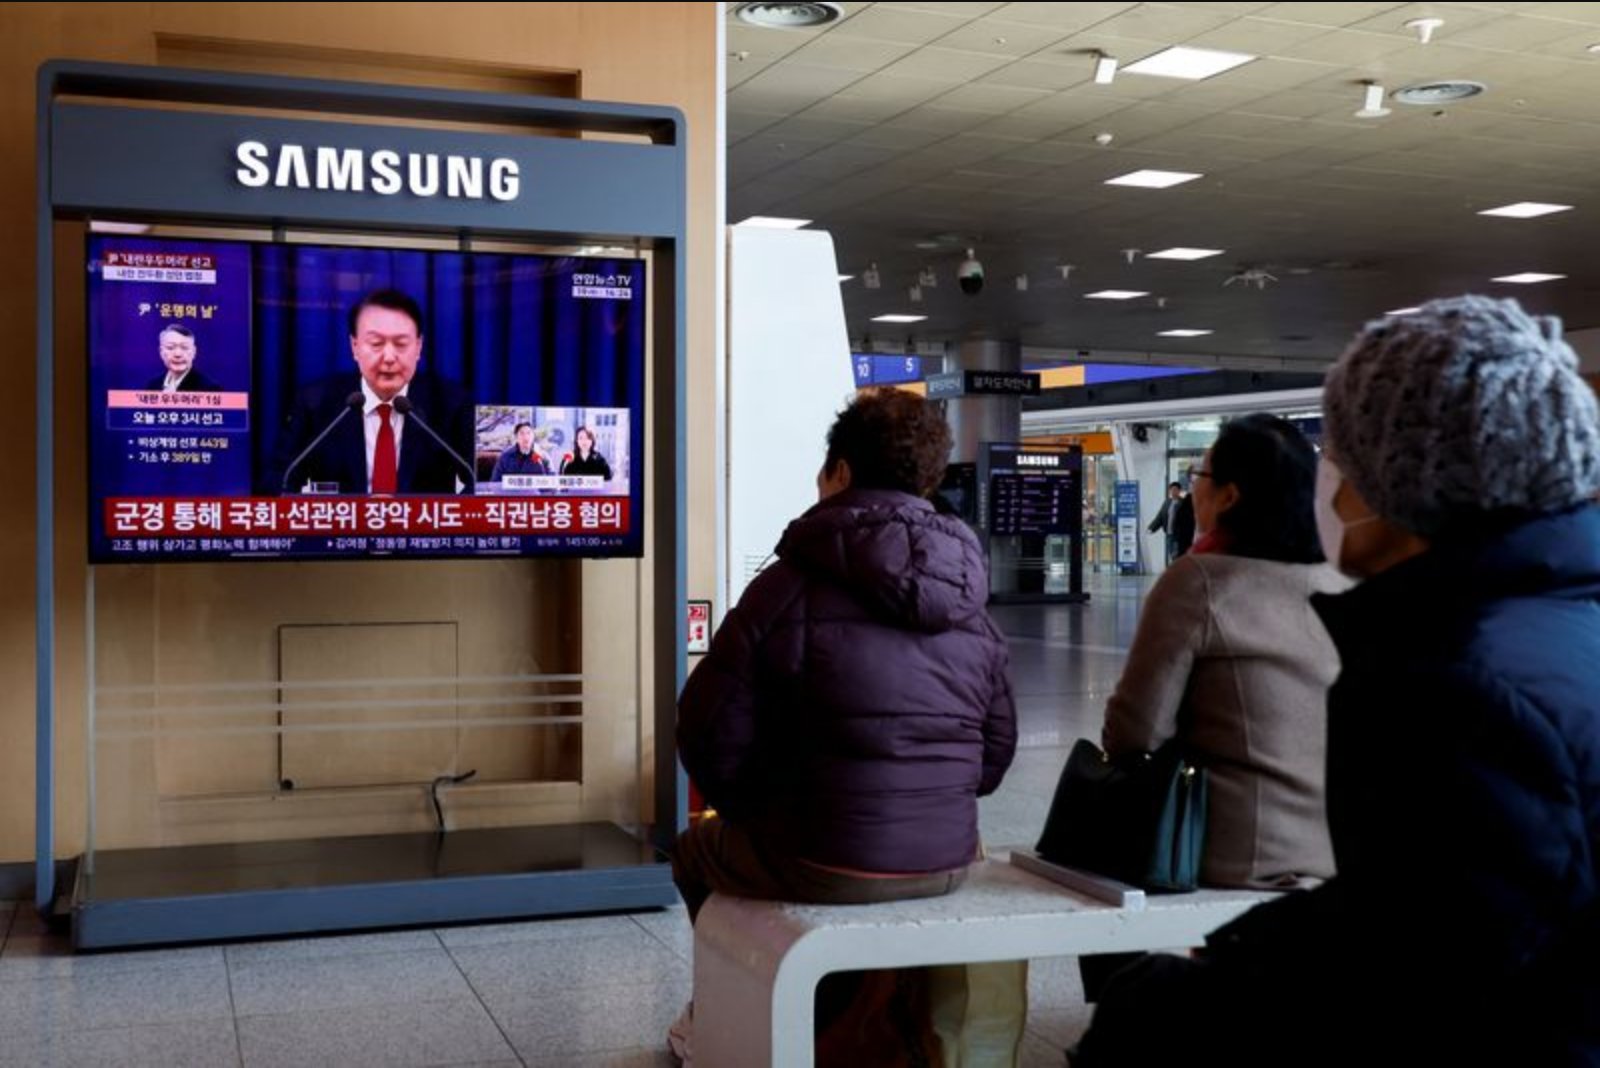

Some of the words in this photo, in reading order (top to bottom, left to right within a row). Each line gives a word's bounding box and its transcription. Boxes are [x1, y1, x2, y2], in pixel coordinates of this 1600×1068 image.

[236, 141, 519, 201] SAMSUNG
[905, 357, 914, 373] 5
[132, 411, 156, 425] 오늘
[158, 411, 180, 425] 오후
[182, 411, 200, 425] 3시
[202, 411, 224, 426] 선고
[139, 451, 158, 463] 기소
[1017, 454, 1059, 466] SAMSUNG
[114, 501, 165, 531] 군경
[172, 501, 222, 531] 통해
[228, 501, 357, 531] 국회·선관위
[364, 501, 411, 530] 장악
[579, 501, 622, 529] 혐의
